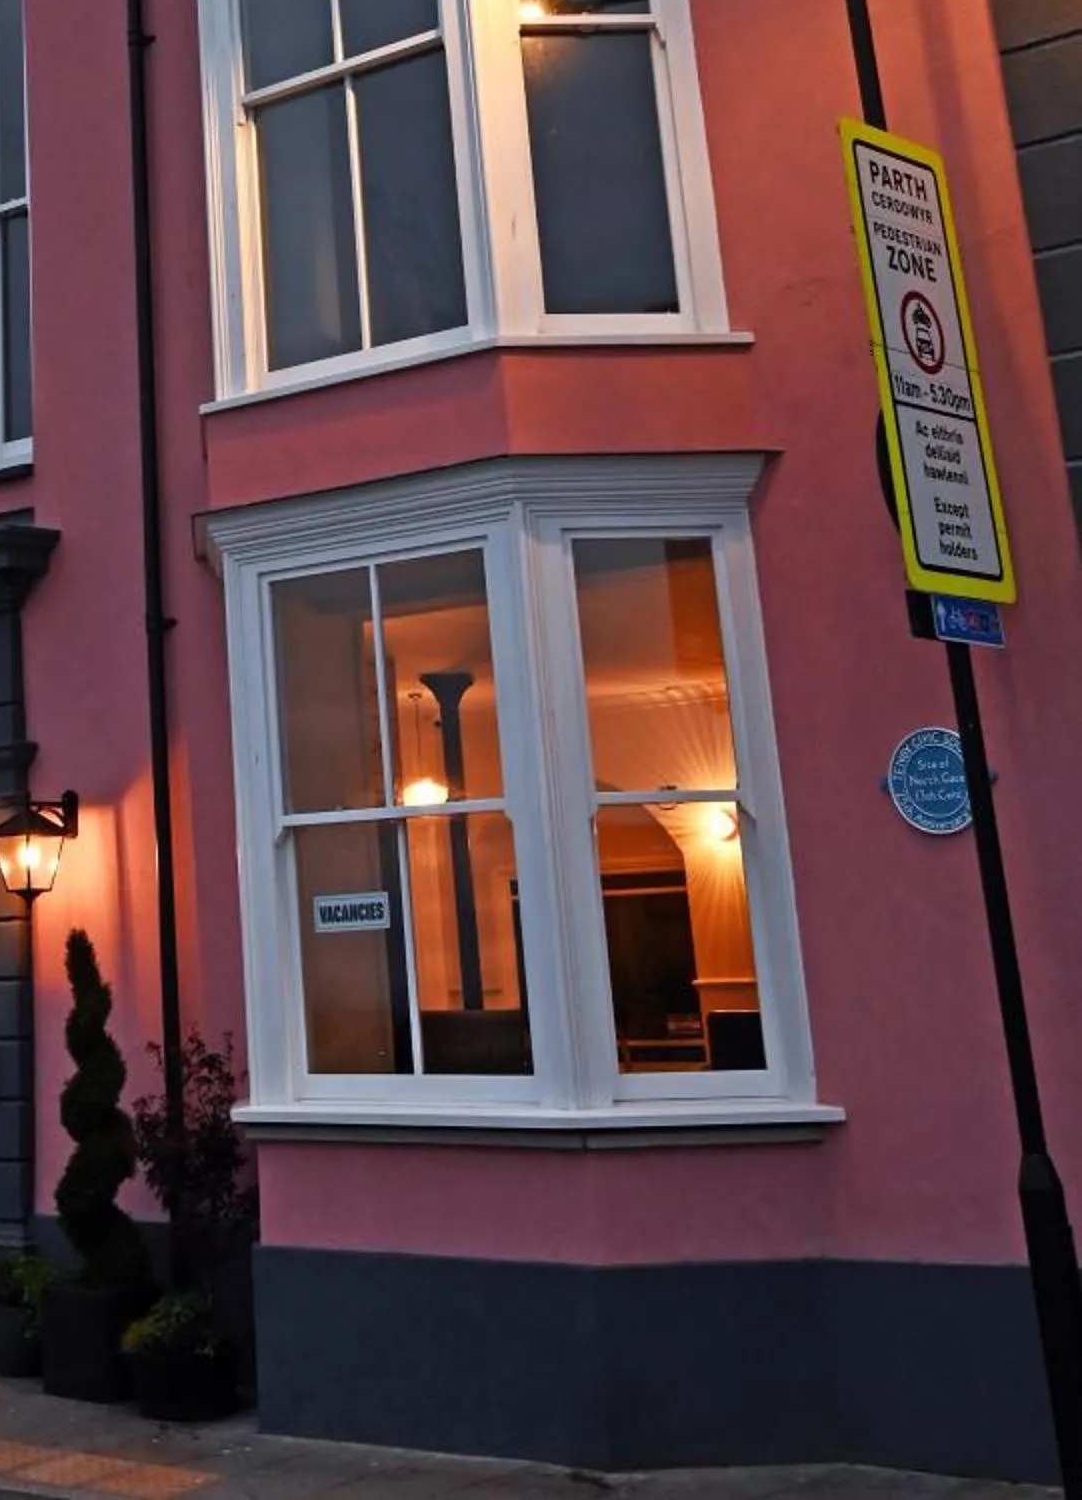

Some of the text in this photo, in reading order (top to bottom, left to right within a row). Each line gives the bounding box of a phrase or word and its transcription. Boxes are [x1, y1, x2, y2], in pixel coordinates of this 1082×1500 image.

[869, 160, 928, 201] PARTH
[873, 221, 943, 257] PEDESTRIAN
[886, 245, 937, 283] ZONE
[934, 497, 970, 519] Except
[938, 521, 973, 540] permit
[939, 540, 979, 561] holders
[319, 902, 385, 925] VACANCIES
